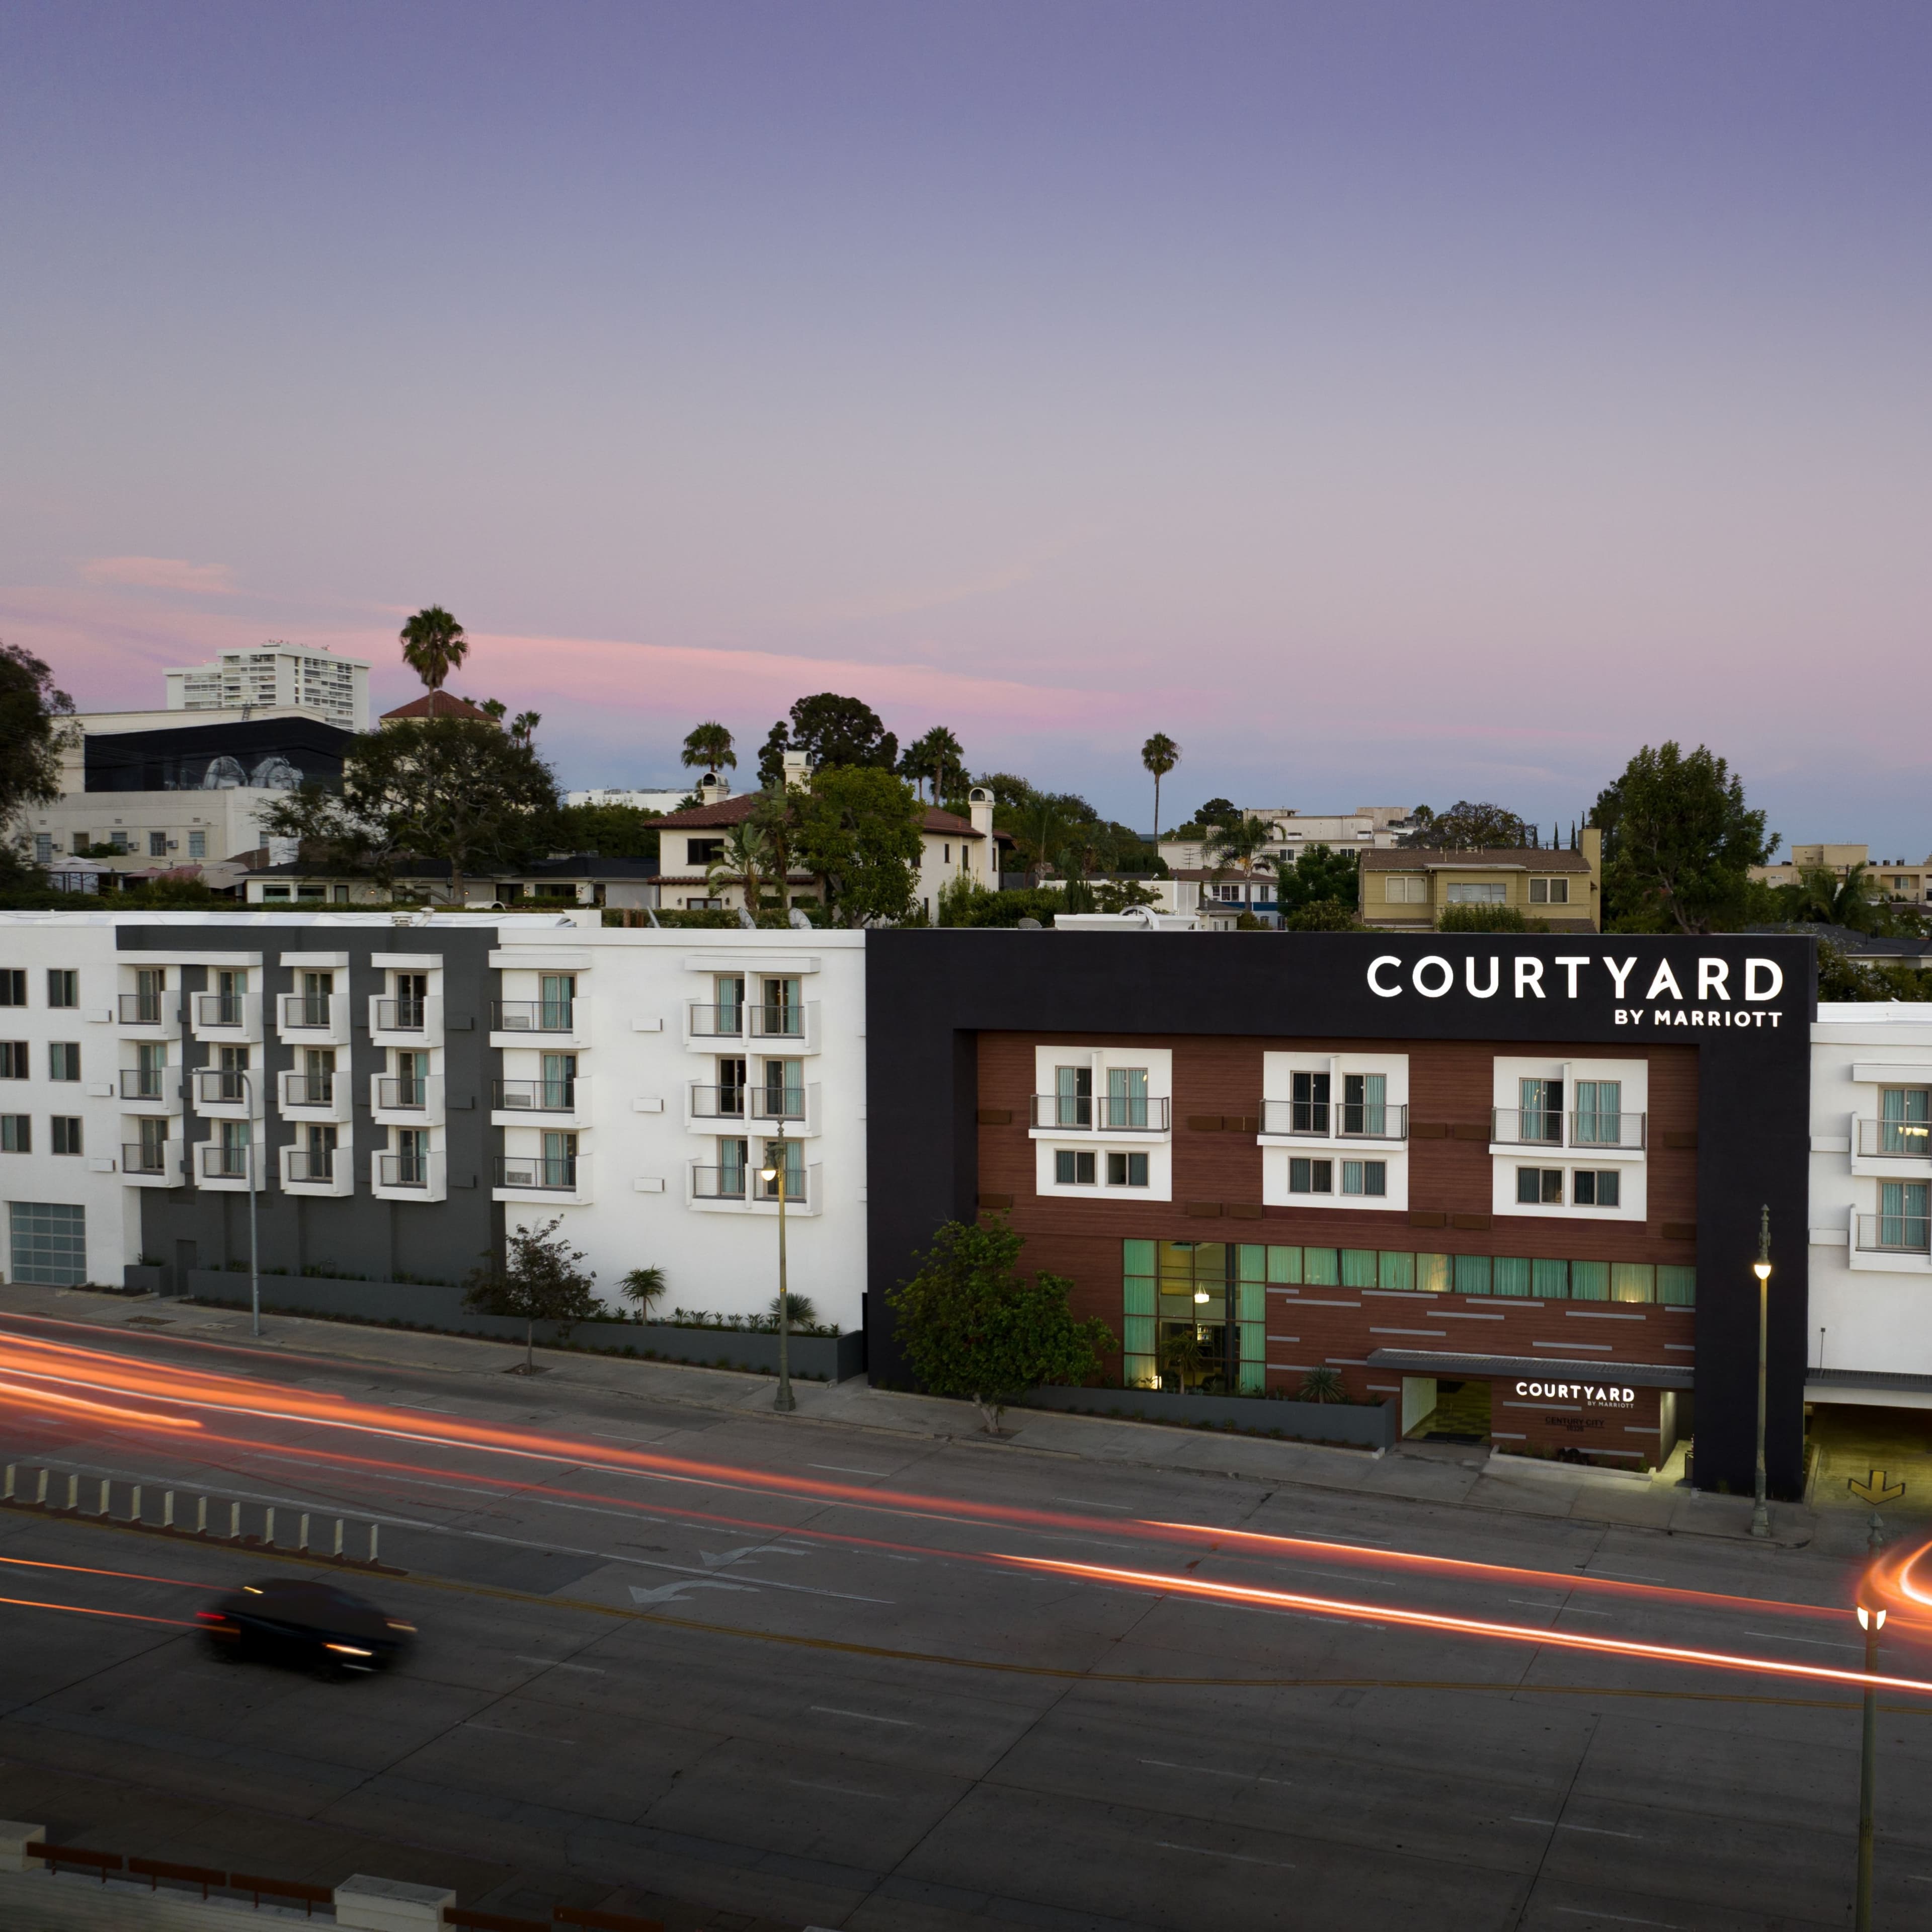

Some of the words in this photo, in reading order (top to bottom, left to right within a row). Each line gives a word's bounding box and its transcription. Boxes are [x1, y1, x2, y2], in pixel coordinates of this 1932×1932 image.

[1366, 955, 1784, 1001] COURTYARD
[1615, 1009, 1644, 1025] BY
[1654, 1010, 1783, 1027] MARRIOTT
[1515, 1382, 1635, 1402] COURTYARD
[1546, 1416, 1584, 1425] CENTURY
